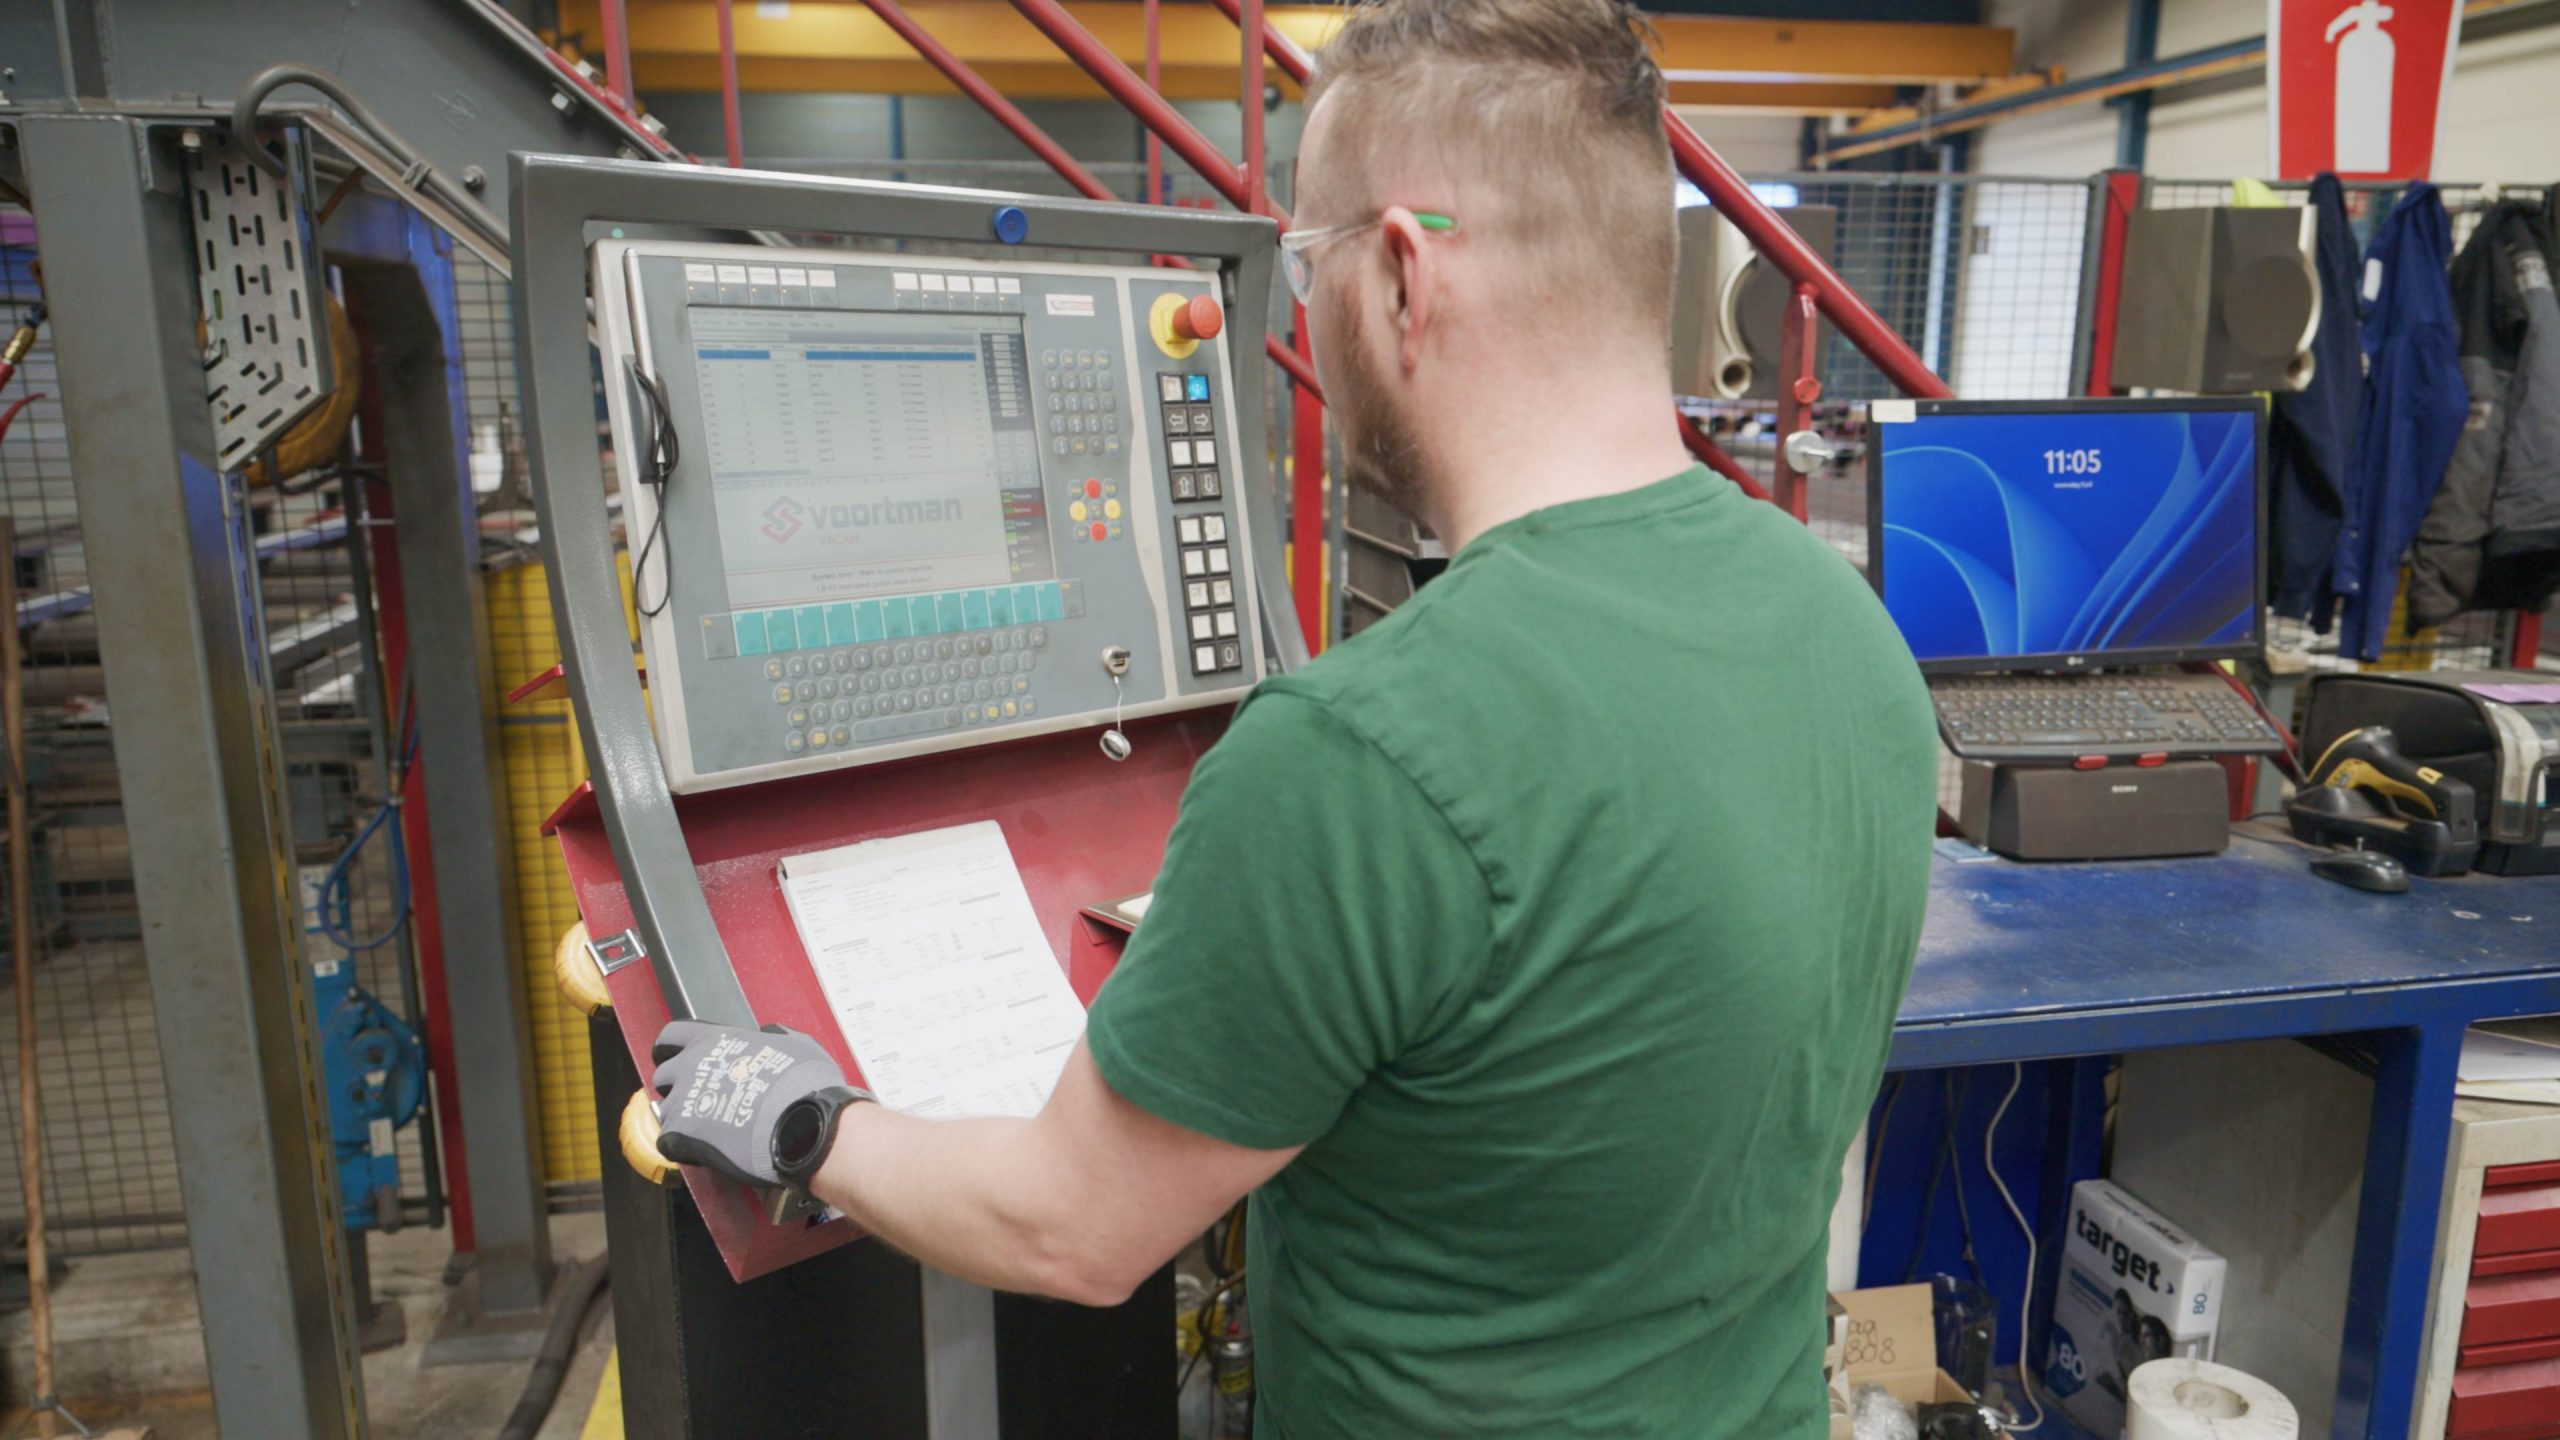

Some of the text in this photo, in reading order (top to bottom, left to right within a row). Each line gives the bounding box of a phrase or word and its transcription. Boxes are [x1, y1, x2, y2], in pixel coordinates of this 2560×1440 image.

[2043, 449, 2102, 474] 11:05
[808, 496, 963, 529] voortman
[681, 1036, 730, 1117] MaxiFlex
[2076, 1209, 2161, 1292] target
[2193, 1293, 2208, 1314] 80
[2059, 1343, 2086, 1380] 80
